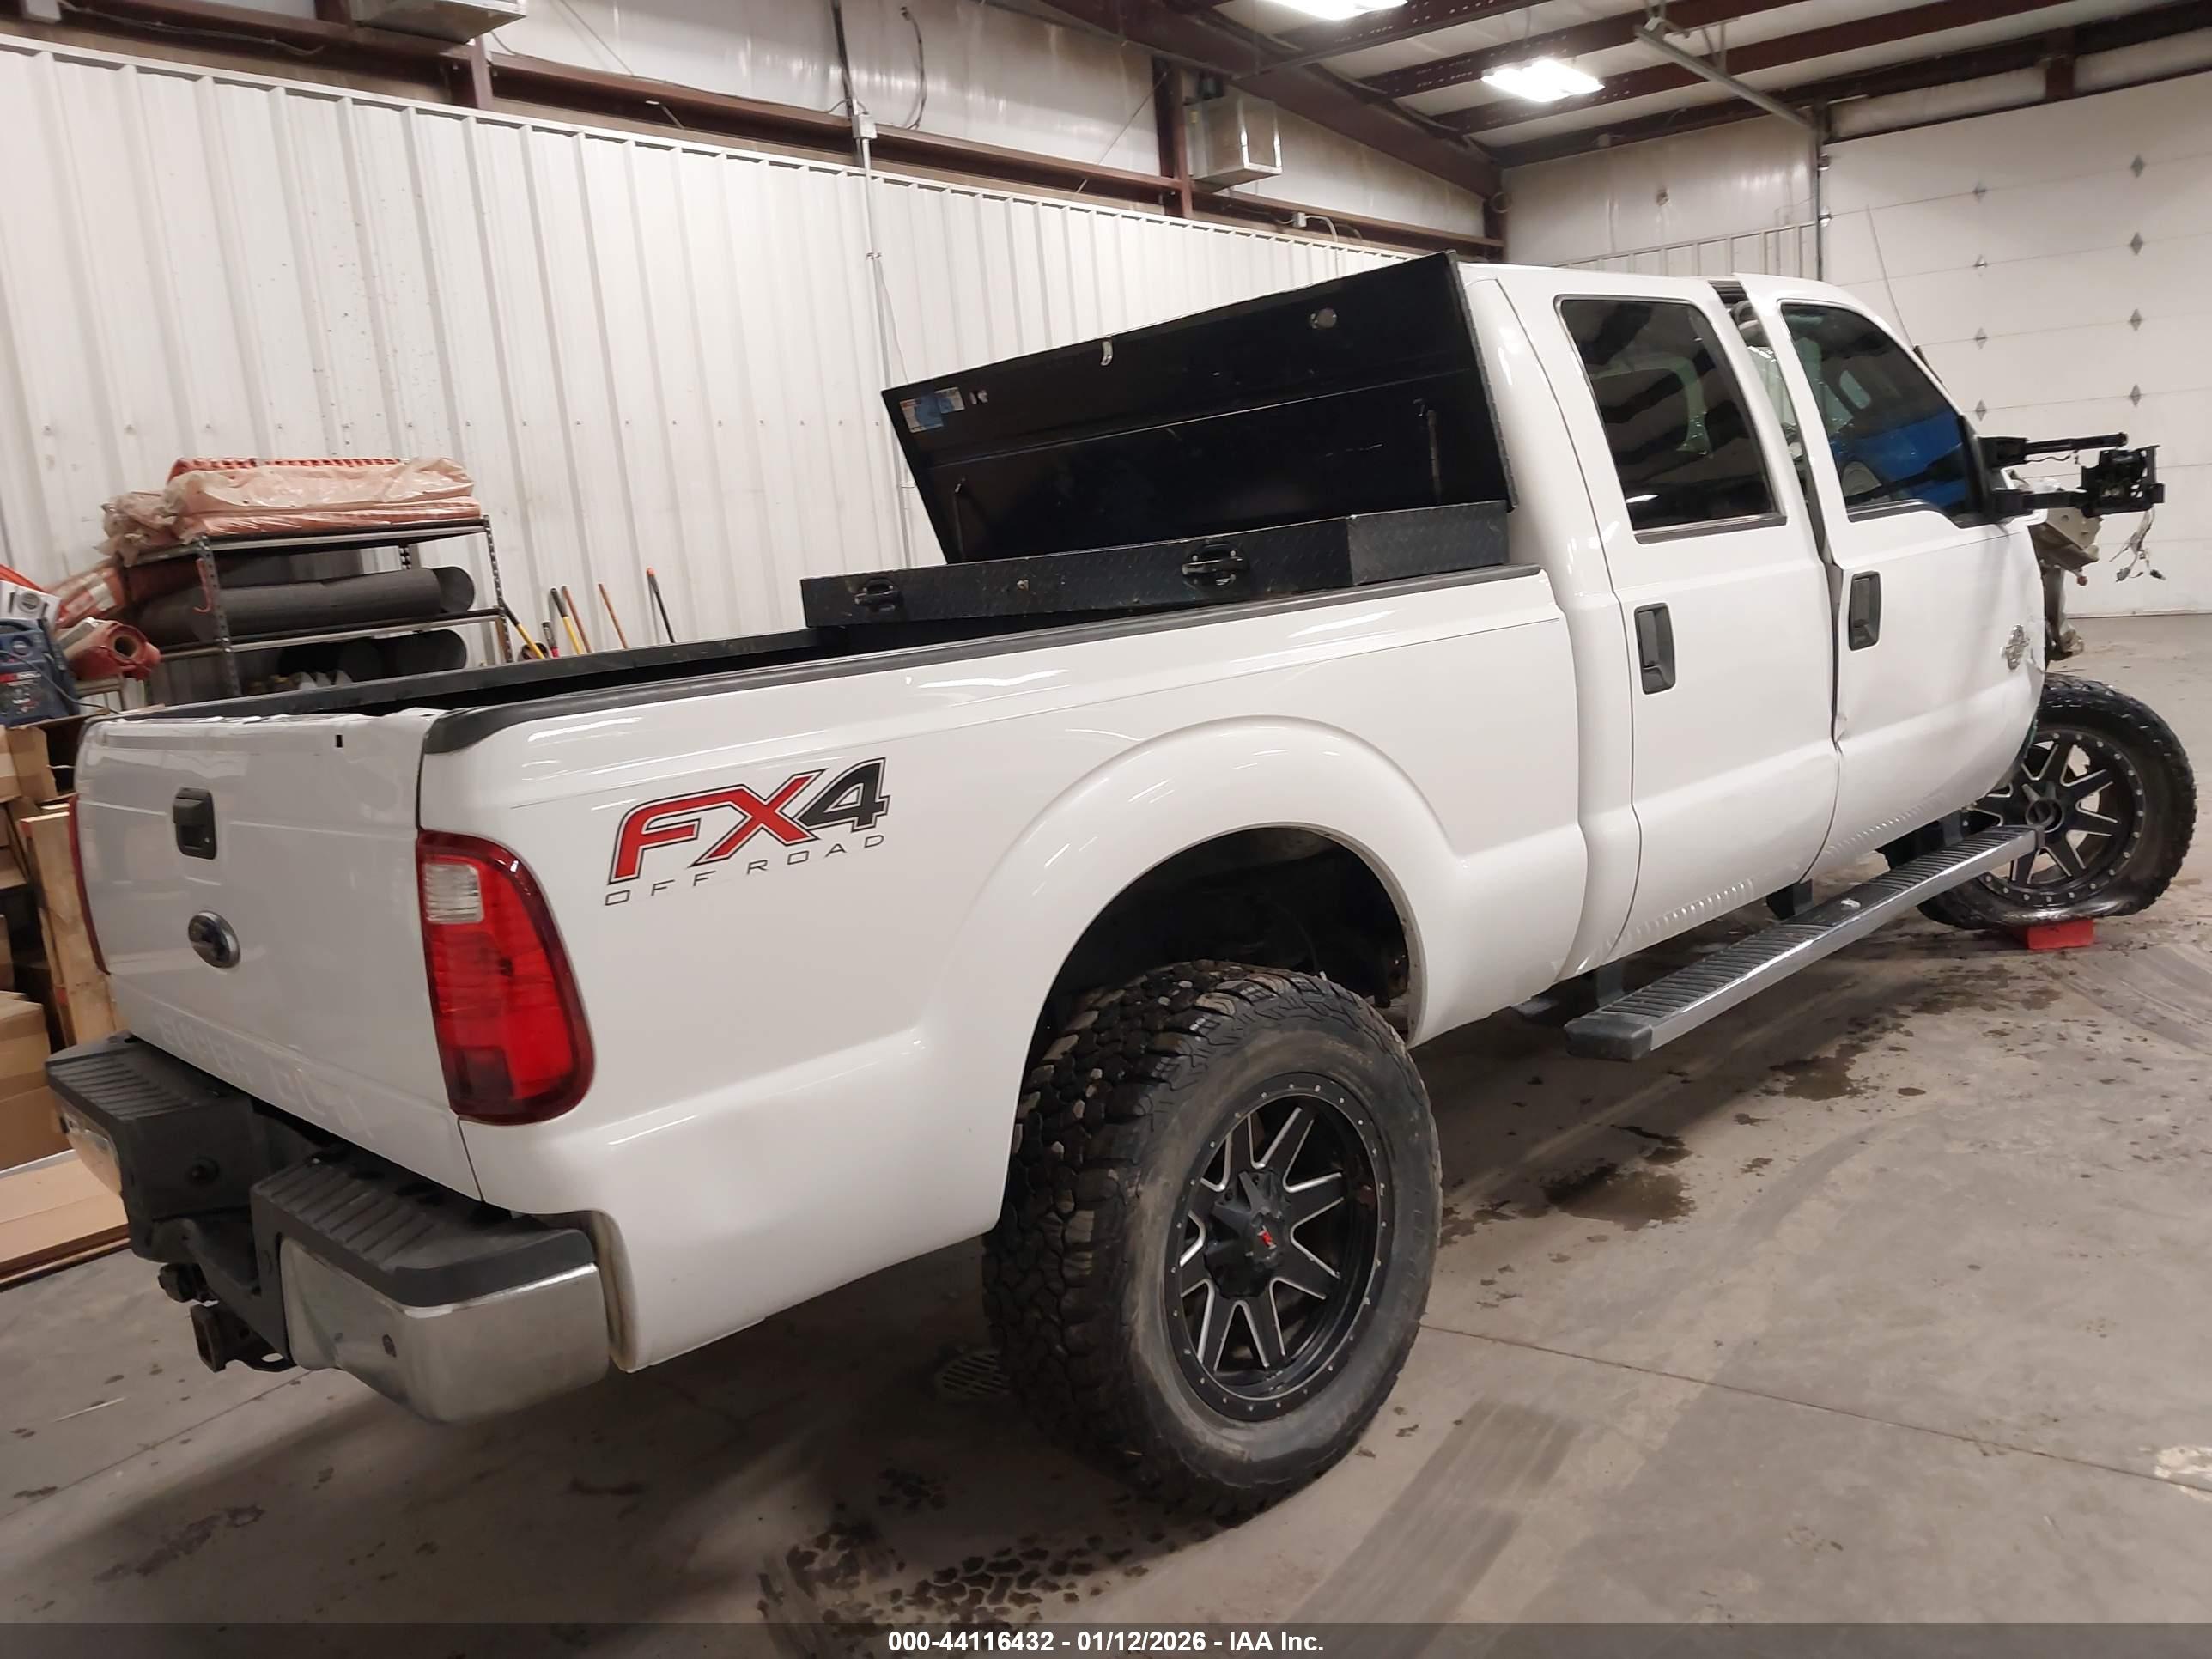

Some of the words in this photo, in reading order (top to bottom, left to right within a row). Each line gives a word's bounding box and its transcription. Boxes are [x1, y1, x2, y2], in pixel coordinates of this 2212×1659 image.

[604, 870, 717, 907] OFF
[745, 833, 885, 875] ROAD
[606, 756, 890, 886] FX4
